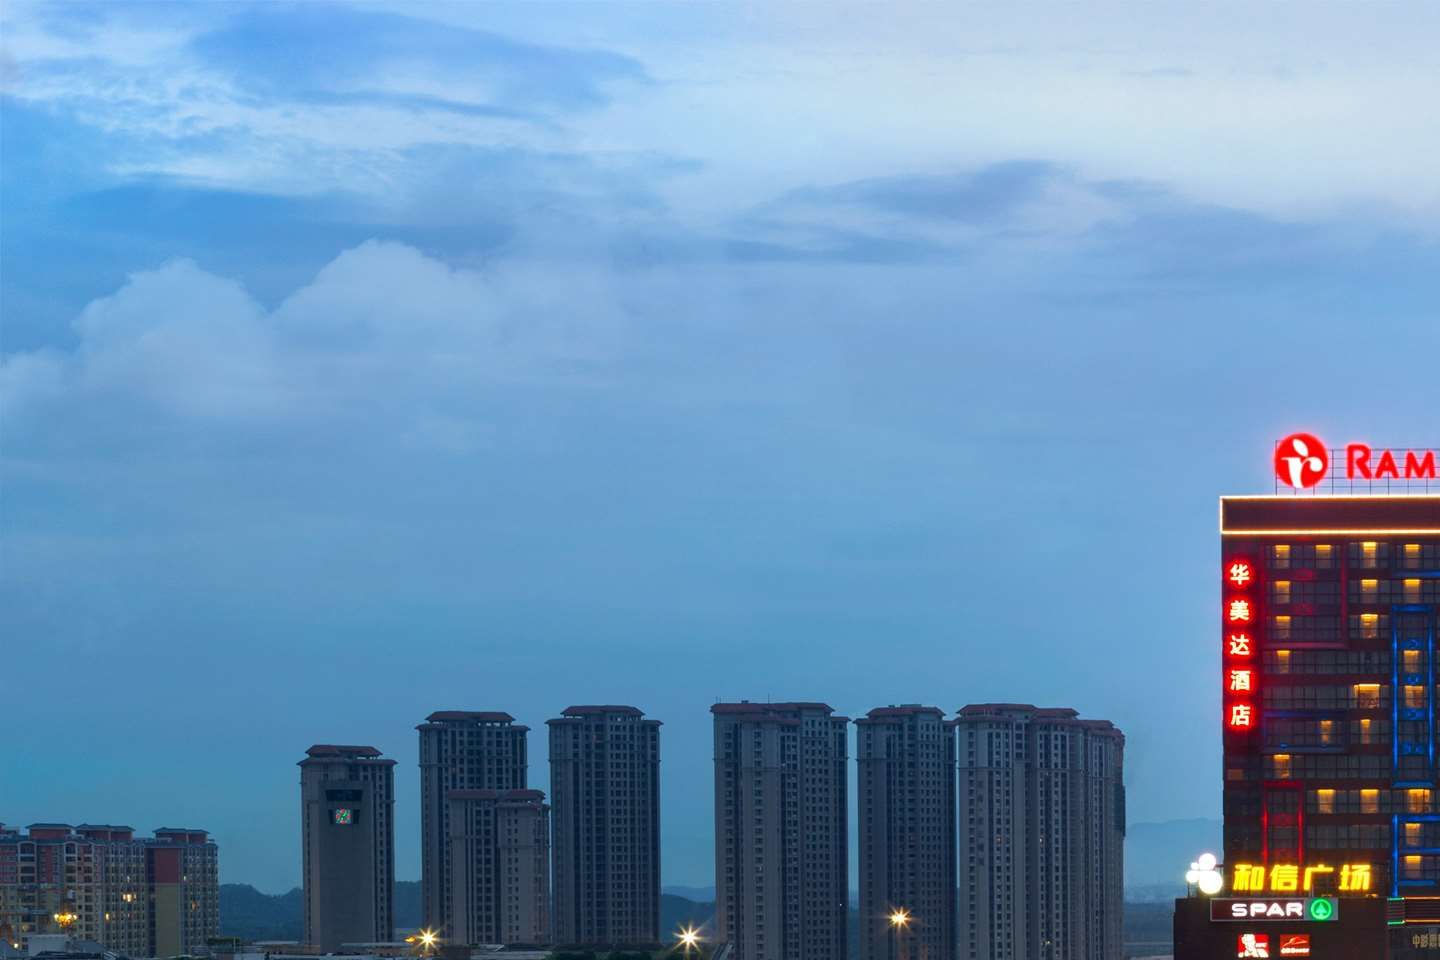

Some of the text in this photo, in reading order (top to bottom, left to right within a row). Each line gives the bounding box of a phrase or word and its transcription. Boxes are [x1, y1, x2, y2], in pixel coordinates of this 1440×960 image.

[1230, 564, 1251, 726] 华美达酒店
[1232, 864, 1372, 891] 和信广场
[1231, 902, 1304, 918] SPAR
